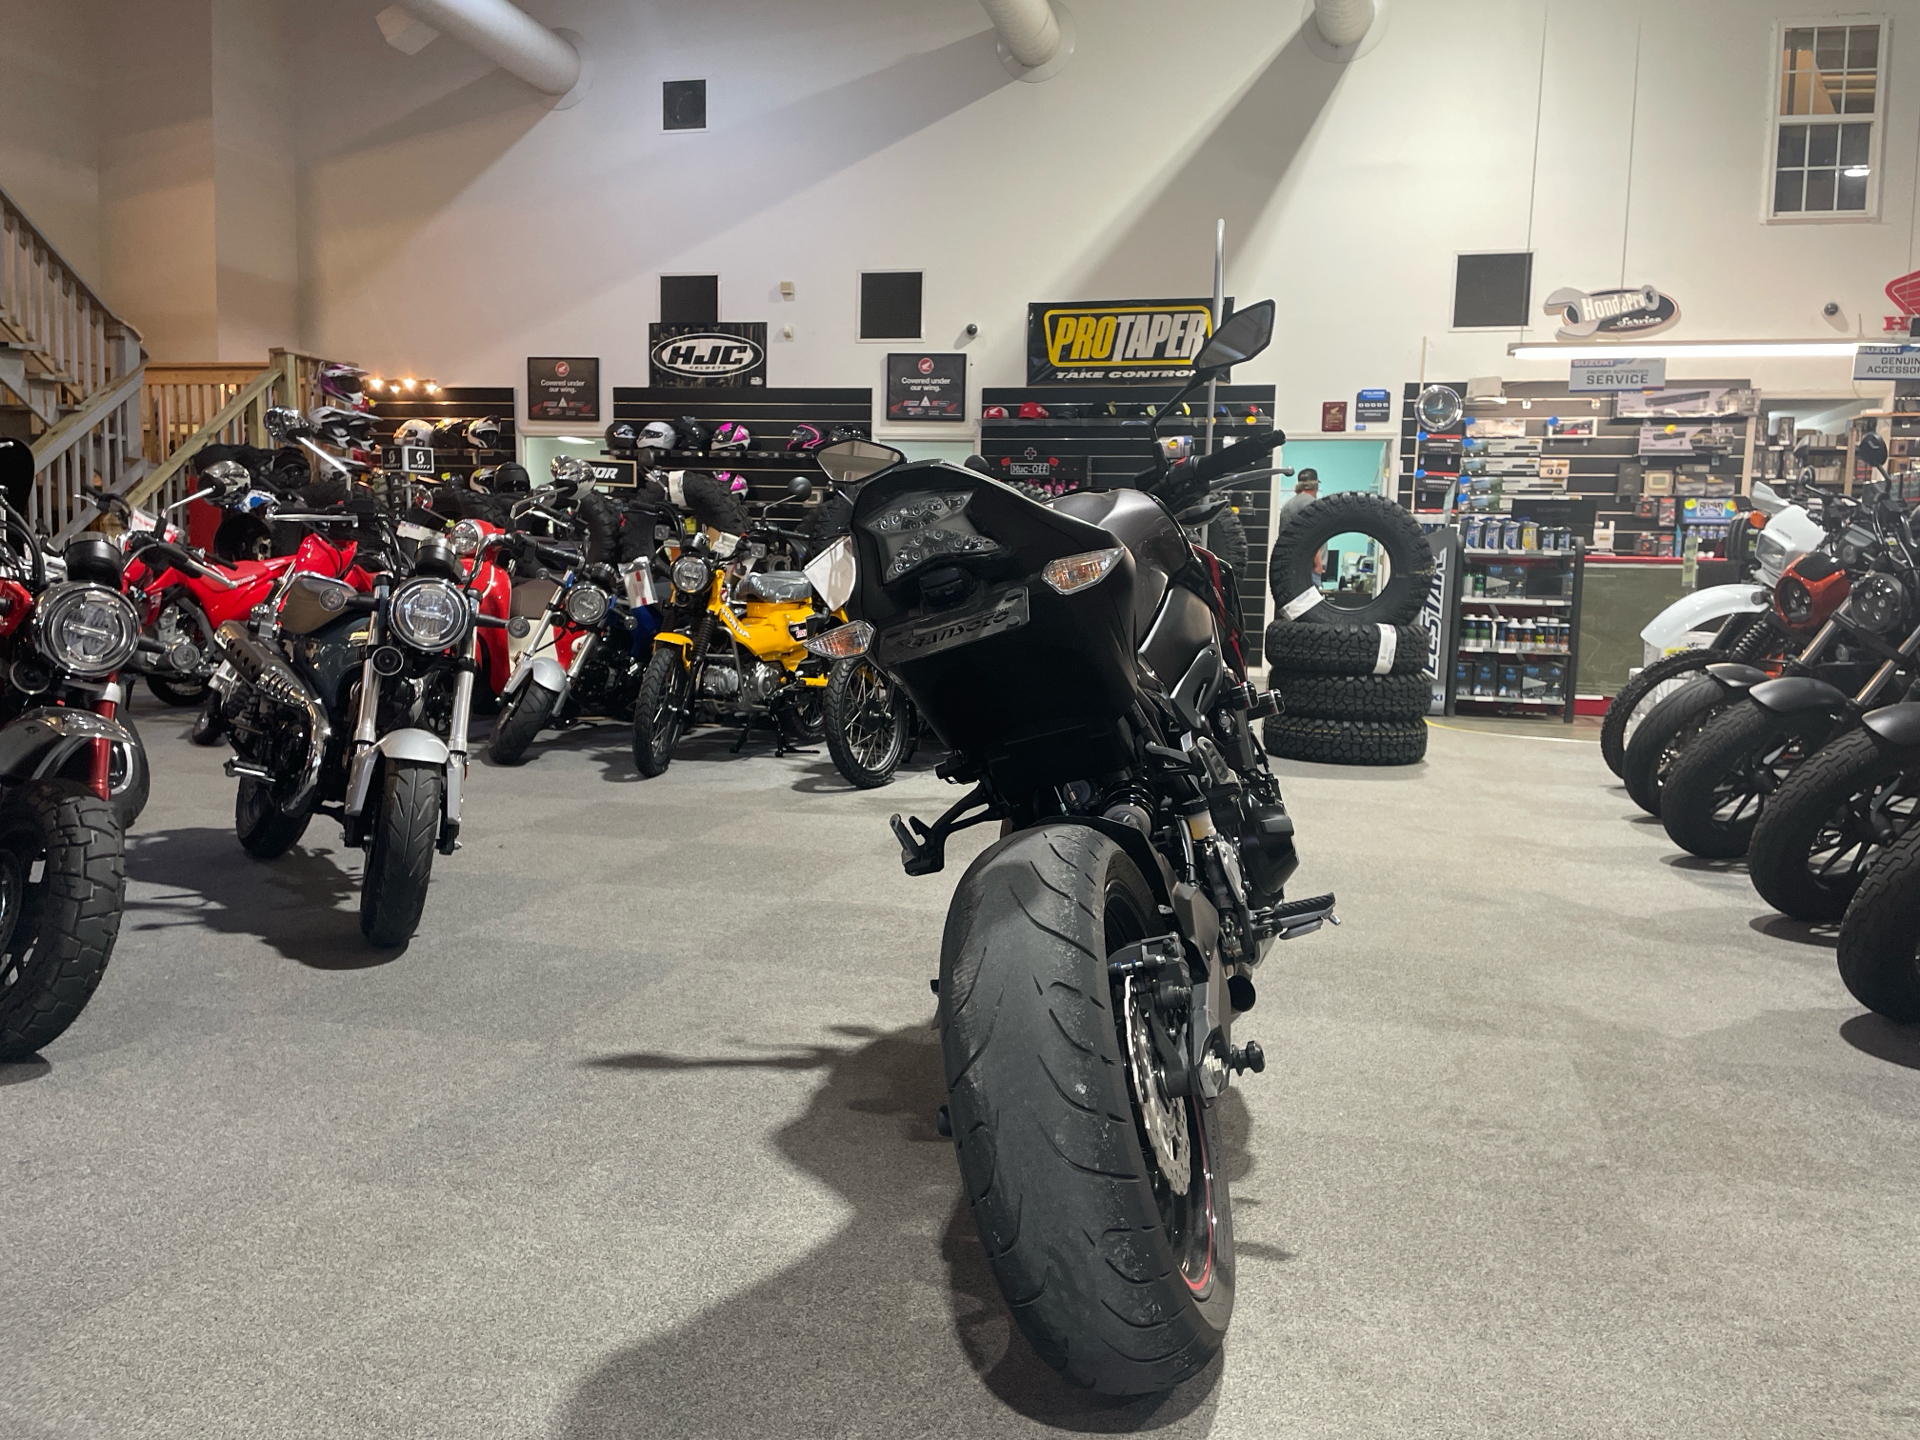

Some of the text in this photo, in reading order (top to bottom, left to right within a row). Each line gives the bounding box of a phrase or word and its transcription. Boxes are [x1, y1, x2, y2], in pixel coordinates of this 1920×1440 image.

[1581, 294, 1646, 321] HondaPro
[1616, 315, 1662, 327] Service
[1050, 313, 1207, 362] PROTAPER
[667, 345, 749, 365] HJC
[1573, 359, 1614, 367] SUZUKI
[1881, 357, 1920, 365] GENUIN
[1056, 371, 1105, 379] TAKE
[1867, 366, 1920, 374] ACCESSO
[541, 379, 567, 387] Covered
[1586, 374, 1649, 385] SERVICE
[593, 466, 618, 479] OR
[1012, 463, 1047, 474] Muc-Off
